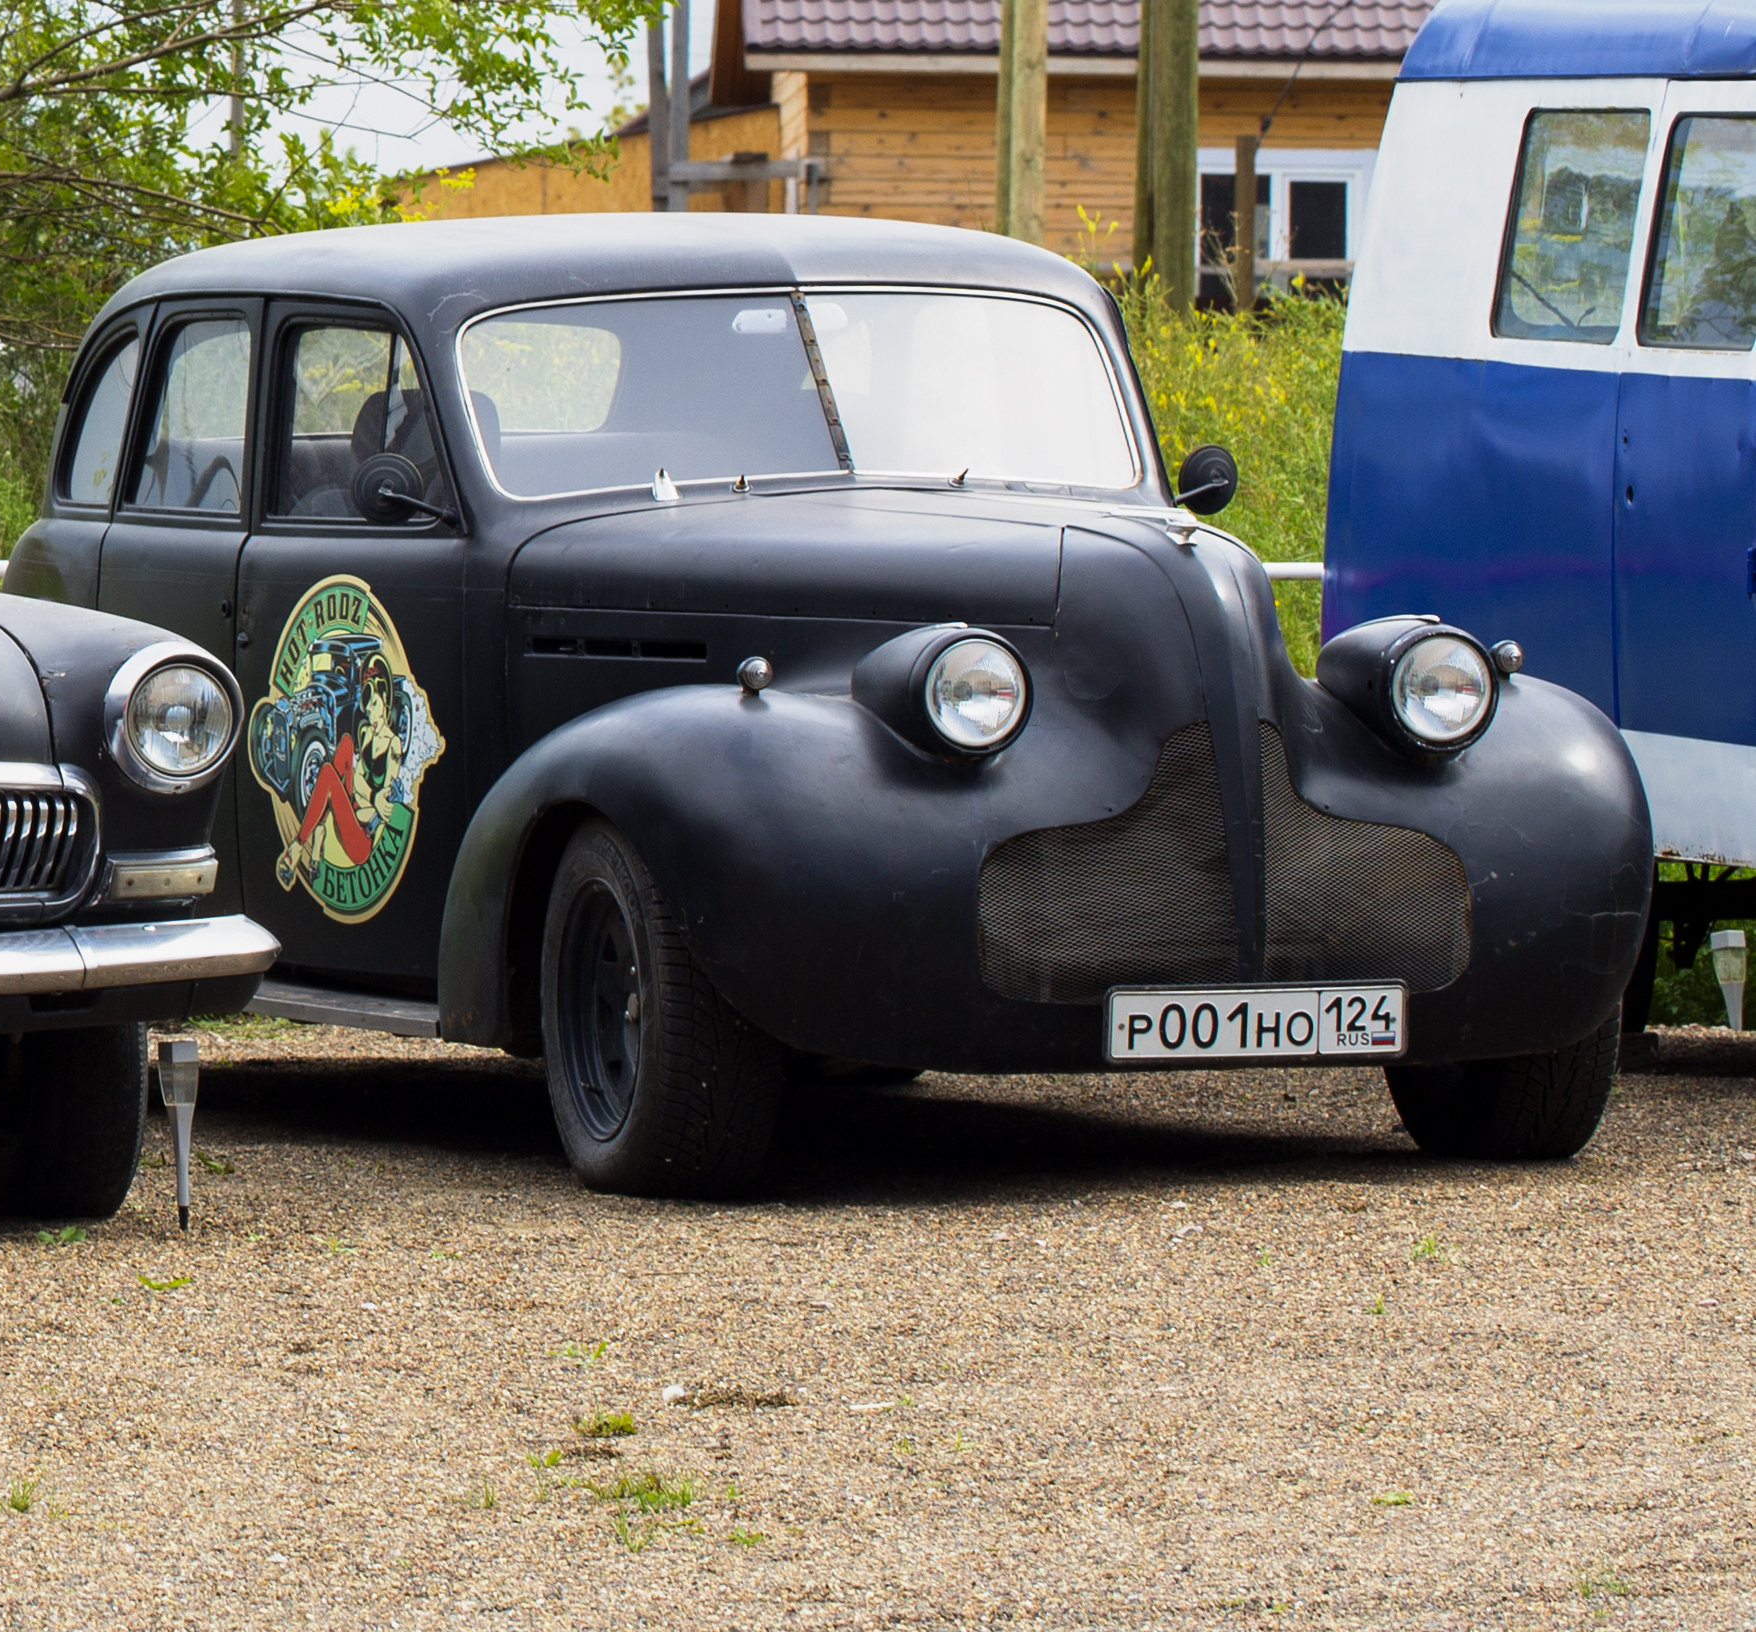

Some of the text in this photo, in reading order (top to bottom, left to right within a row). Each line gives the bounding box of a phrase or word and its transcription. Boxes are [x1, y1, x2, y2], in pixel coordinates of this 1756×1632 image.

[279, 592, 363, 688] HOT RODZ
[322, 823, 405, 904] БЕТОНКА
[1324, 995, 1392, 1032] 124
[1338, 1033, 1370, 1046] RUS
